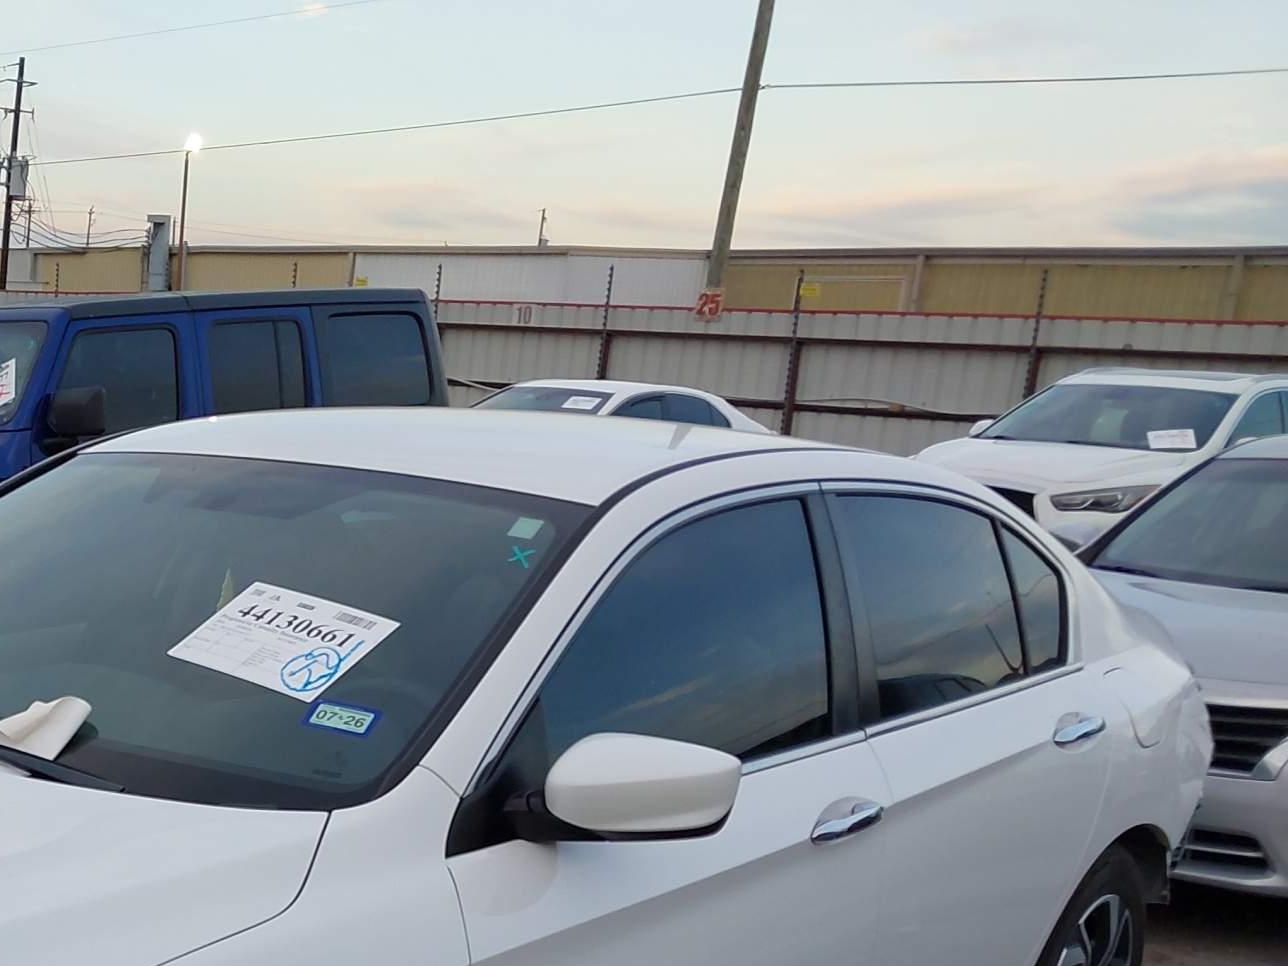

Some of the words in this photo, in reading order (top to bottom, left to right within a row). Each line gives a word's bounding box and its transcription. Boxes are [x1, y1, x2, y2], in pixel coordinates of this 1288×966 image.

[516, 306, 532, 325] 10
[695, 293, 722, 316] 25
[237, 603, 356, 648] 44130661
